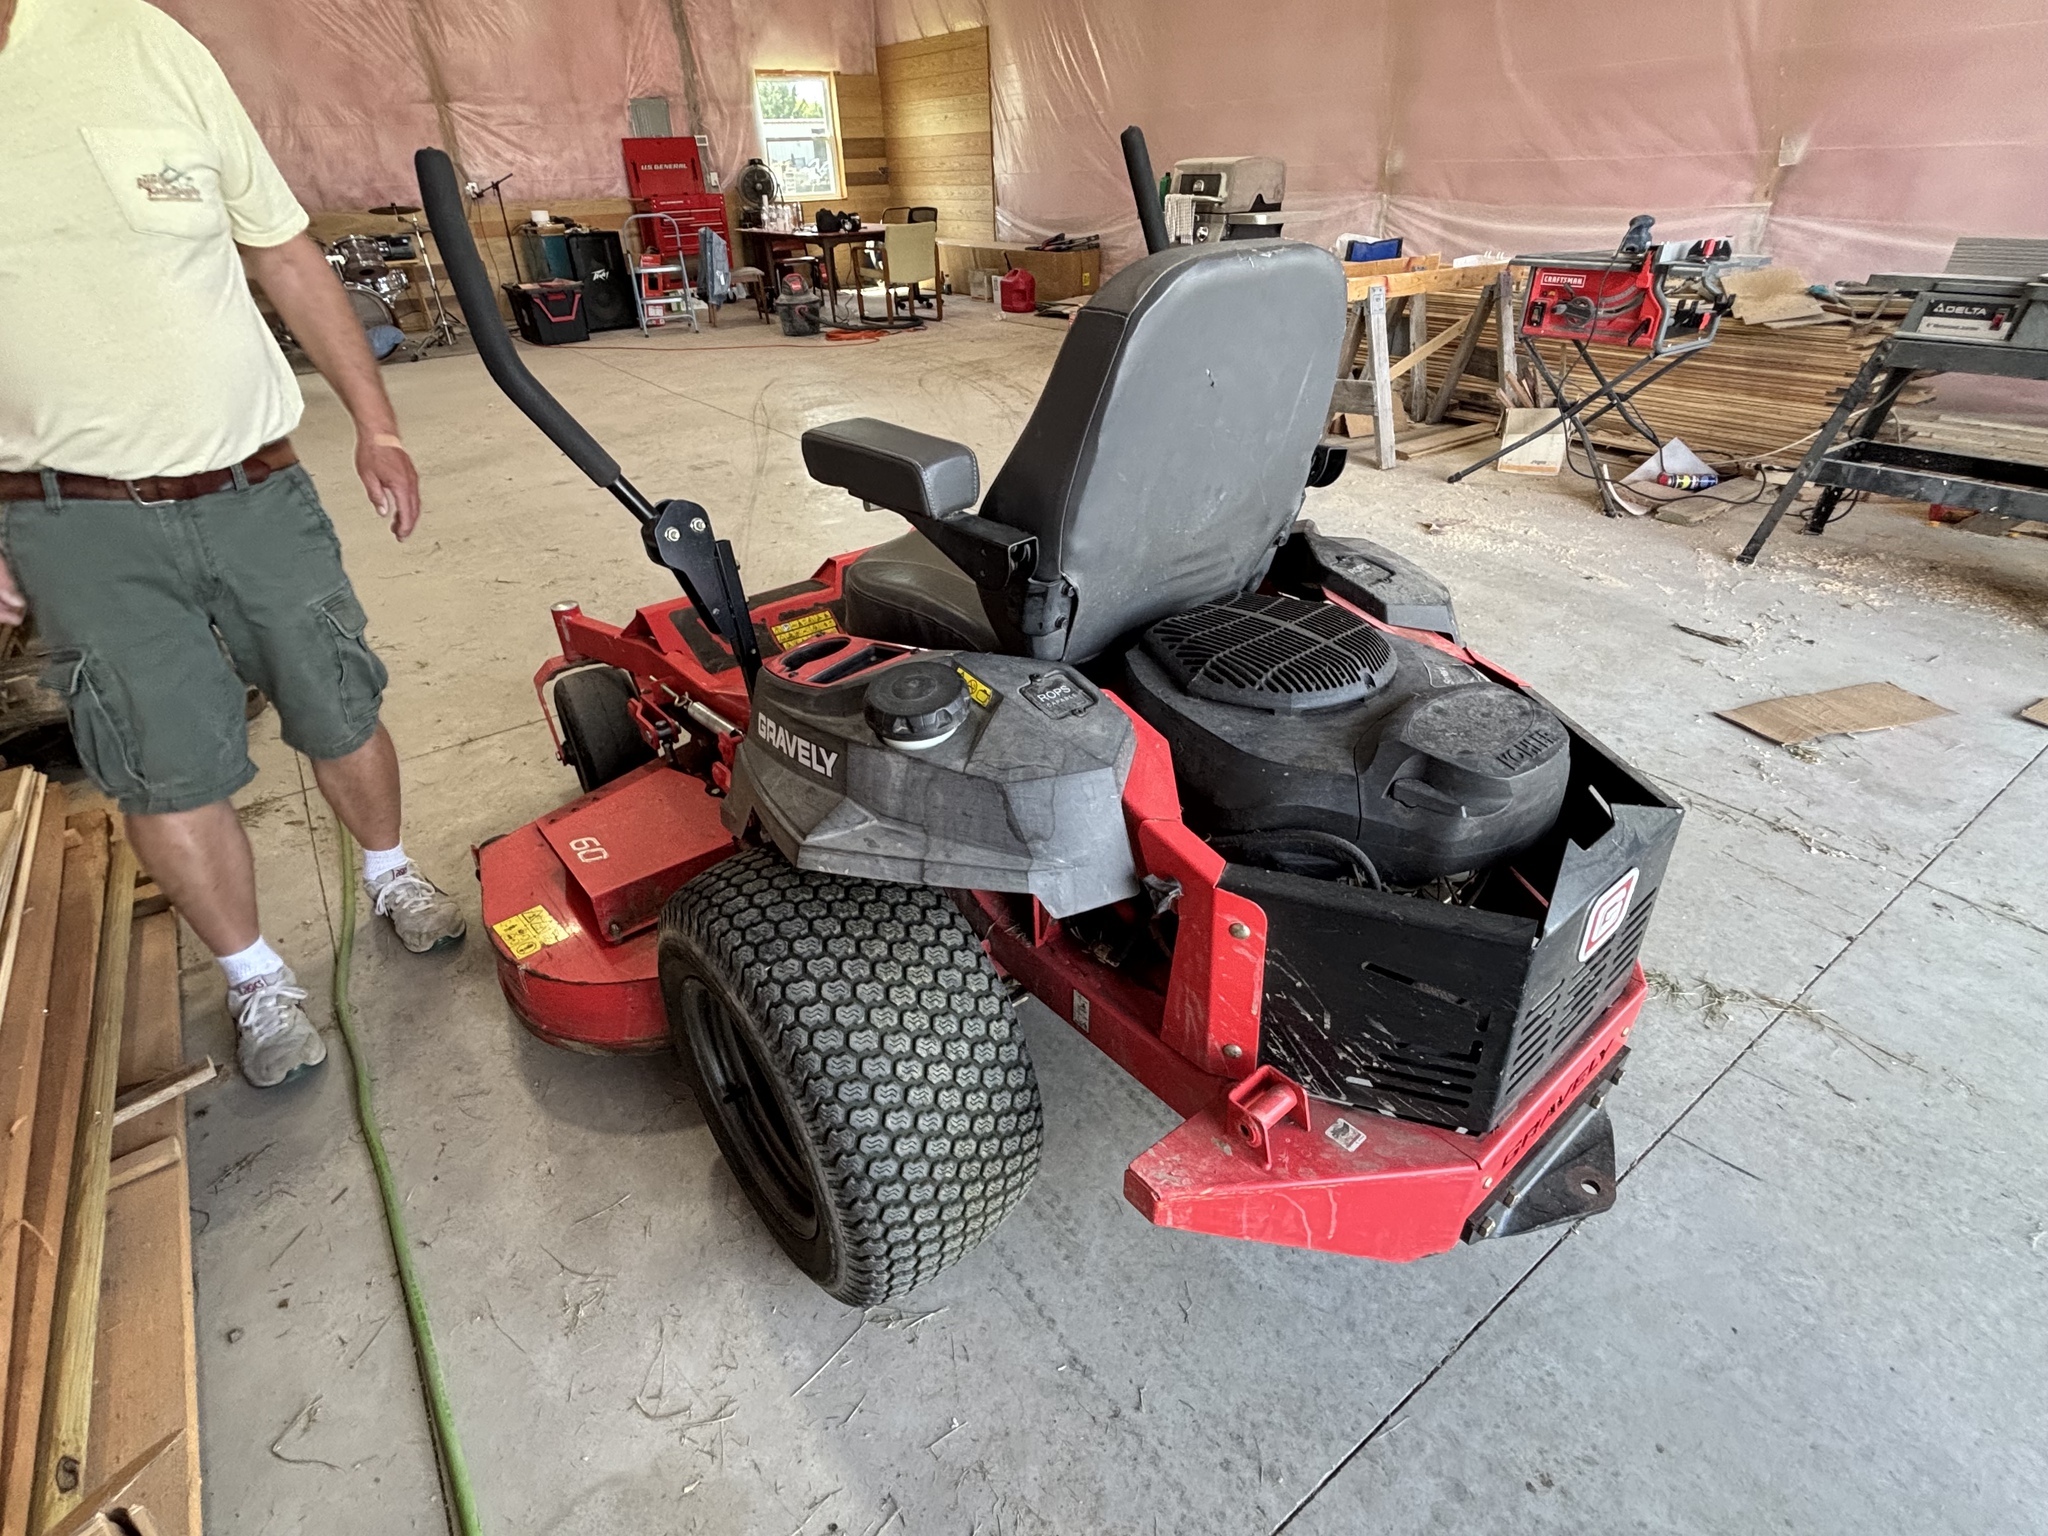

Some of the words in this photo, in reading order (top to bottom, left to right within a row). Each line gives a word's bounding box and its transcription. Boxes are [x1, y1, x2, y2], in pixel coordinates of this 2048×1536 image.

[653, 163, 688, 171] GENERAL
[1543, 275, 1583, 285] CRAFTSMAN
[1944, 304, 1988, 316] DELTA
[1037, 685, 1071, 703] ROPS
[758, 711, 839, 779] GRAVELY
[568, 836, 610, 863] 60
[1500, 1038, 1615, 1171] GRAVELY
